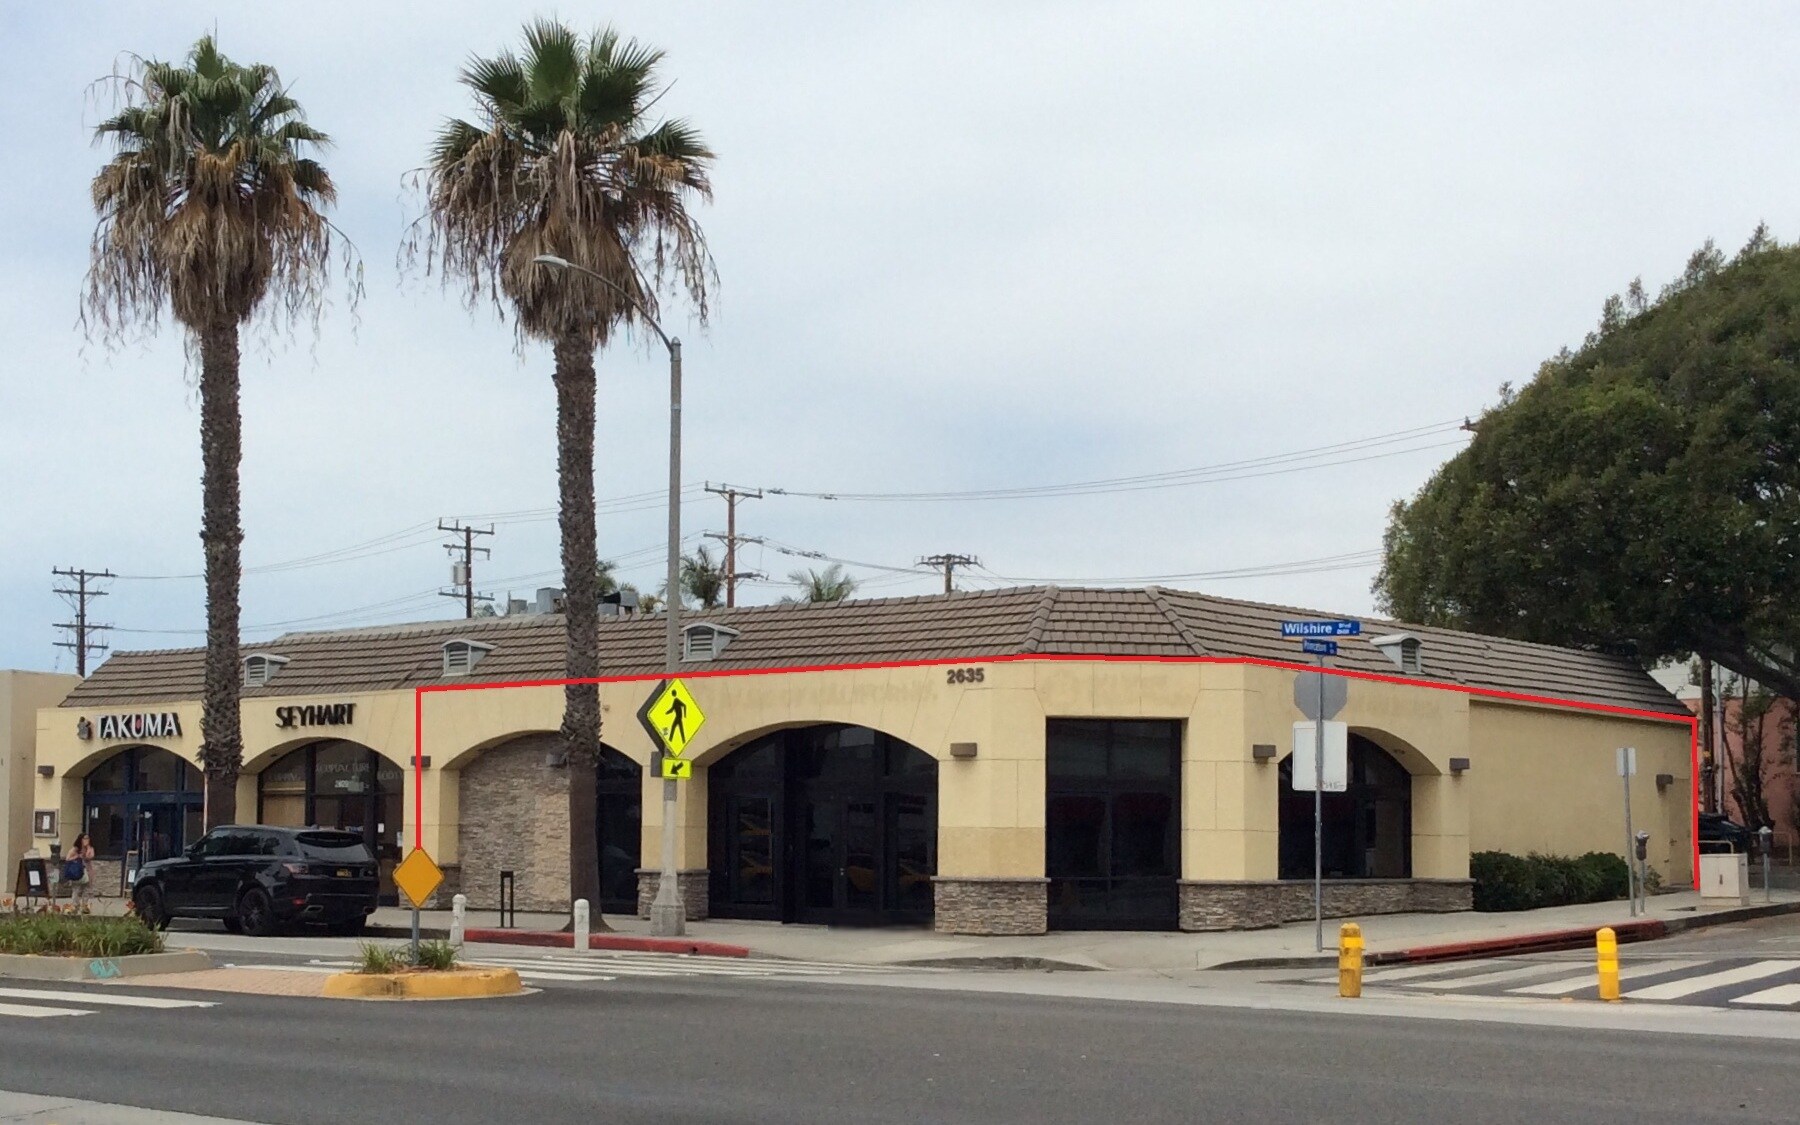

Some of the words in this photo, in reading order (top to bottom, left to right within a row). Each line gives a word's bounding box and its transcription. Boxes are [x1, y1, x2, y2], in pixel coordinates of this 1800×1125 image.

[1284, 623, 1332, 634] Wilshire
[947, 667, 985, 684] 2635
[96, 713, 182, 738] TAKUMA
[275, 703, 356, 729] SEYHART
